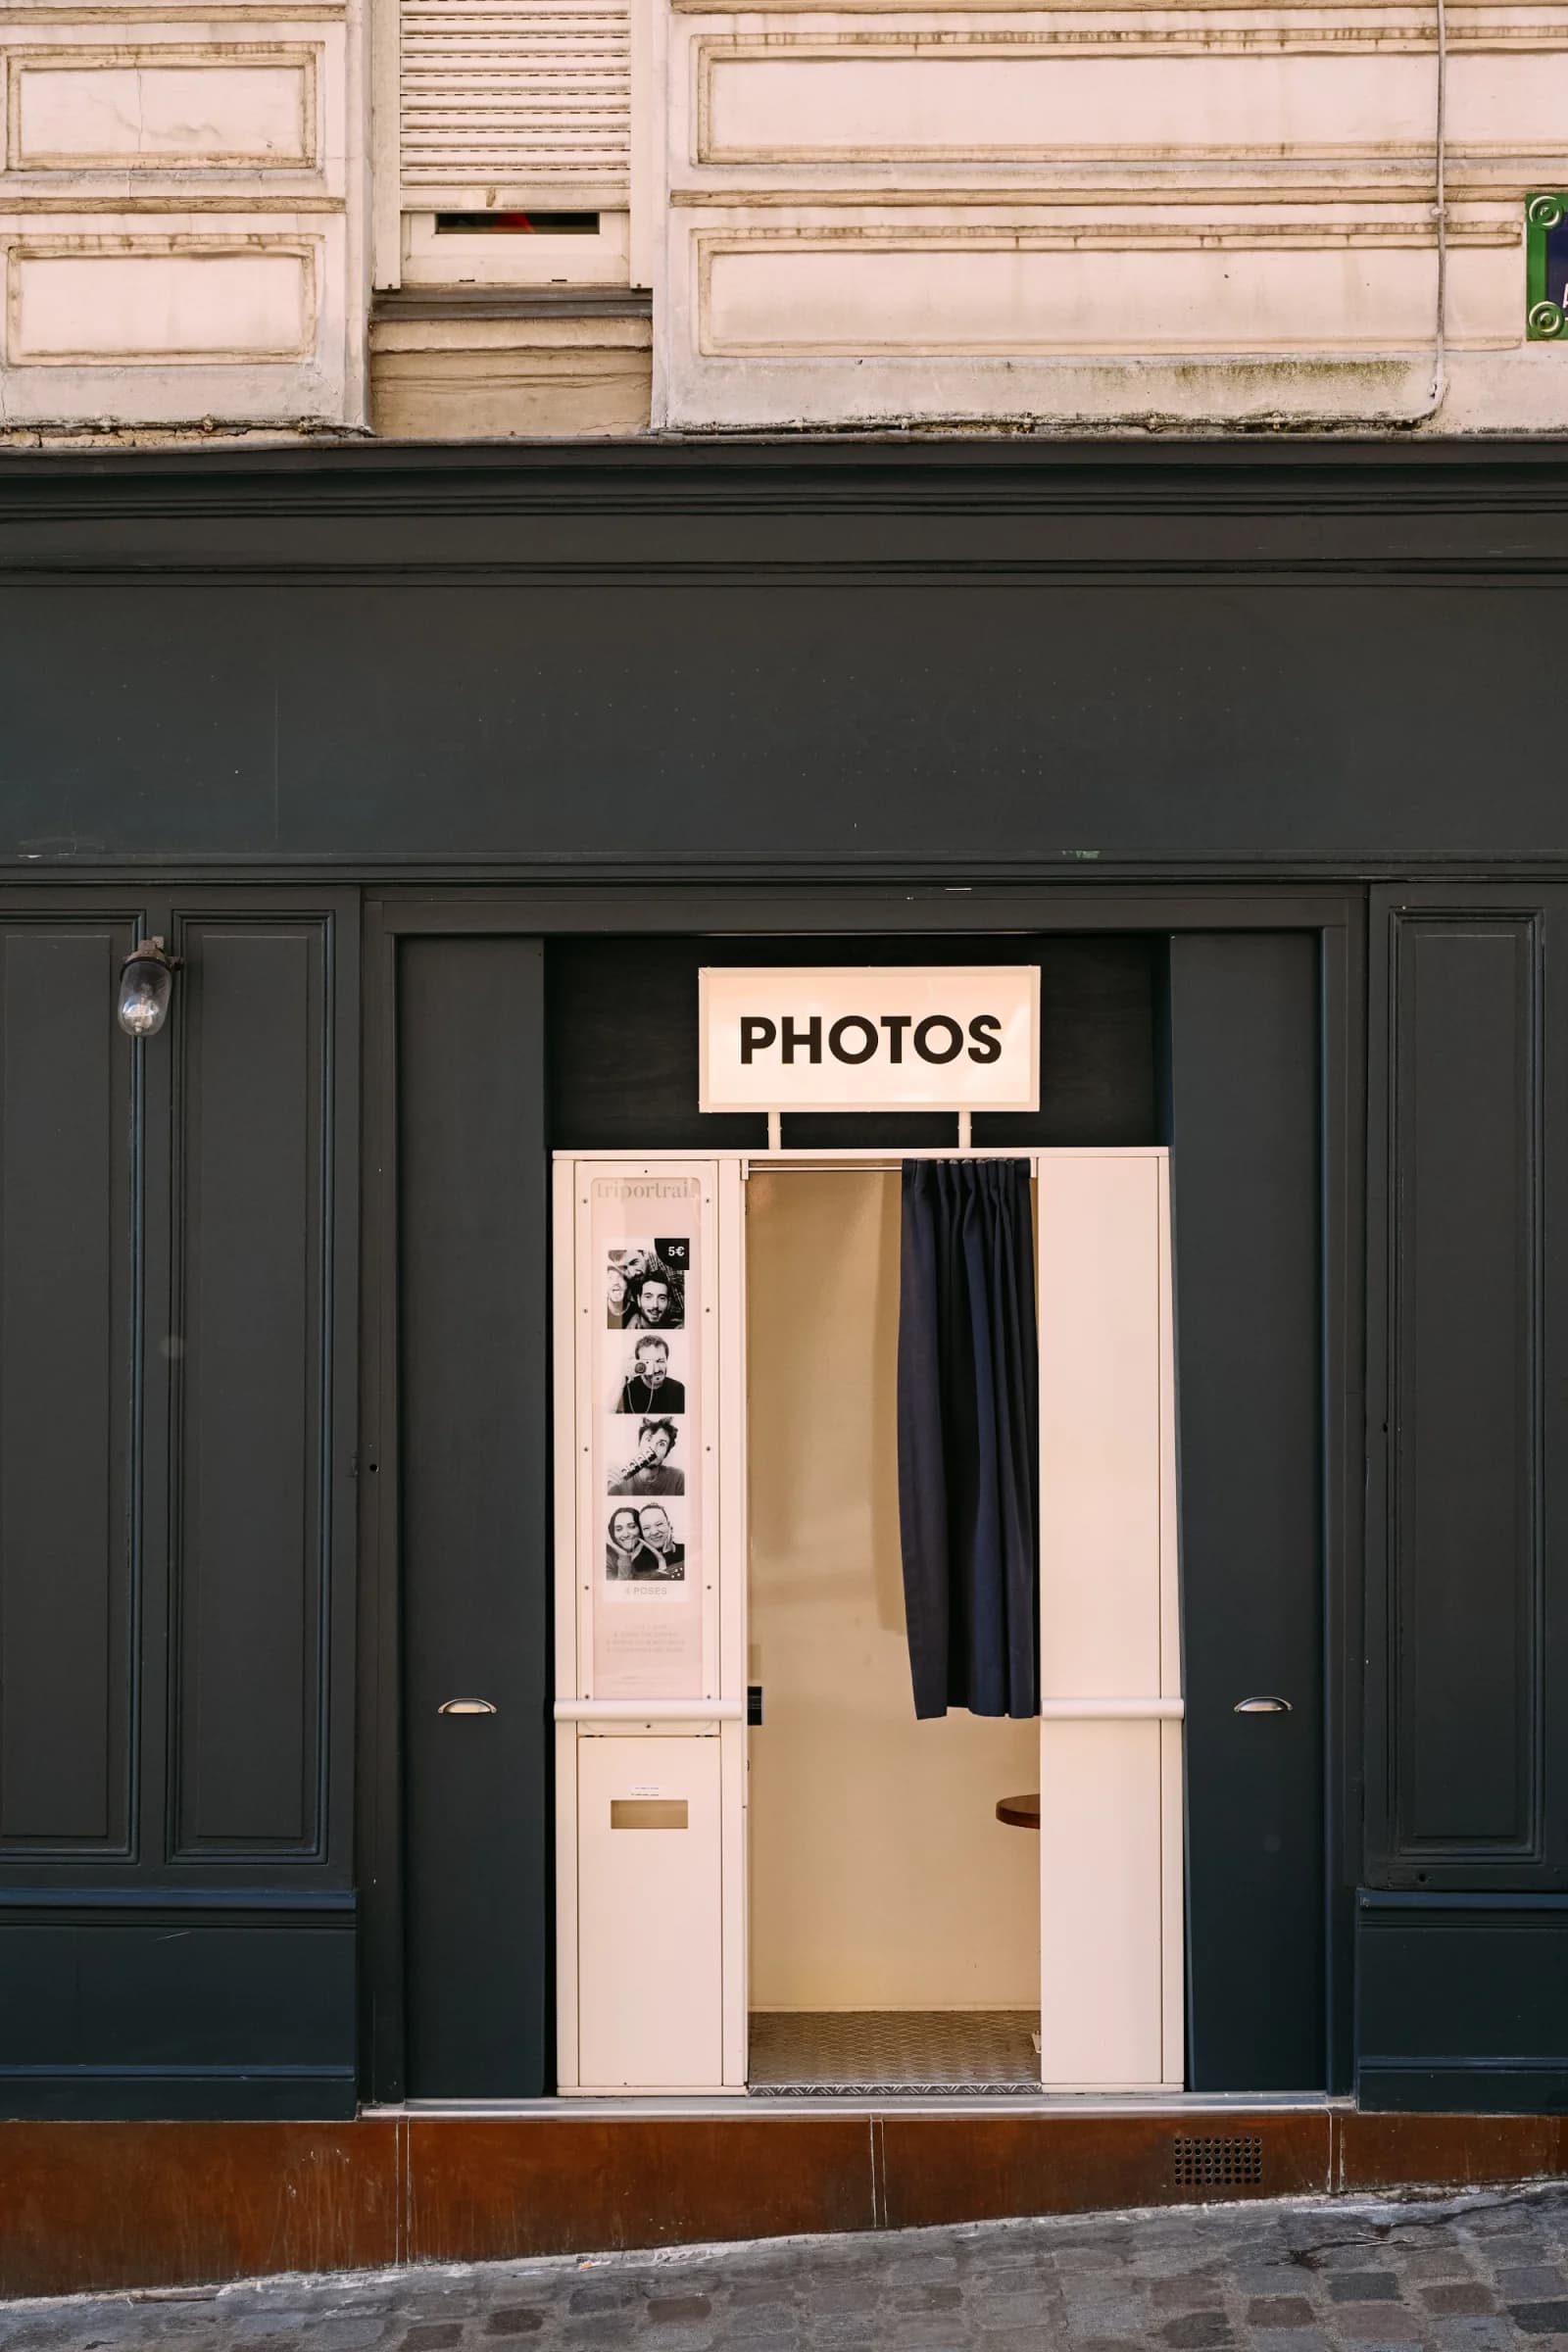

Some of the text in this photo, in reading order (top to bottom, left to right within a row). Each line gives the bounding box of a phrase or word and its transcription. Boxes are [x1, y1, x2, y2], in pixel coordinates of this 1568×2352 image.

[740, 1014, 1003, 1065] PHOTOS
[668, 1246, 685, 1256] 5€
[633, 1587, 667, 1596] POSES
